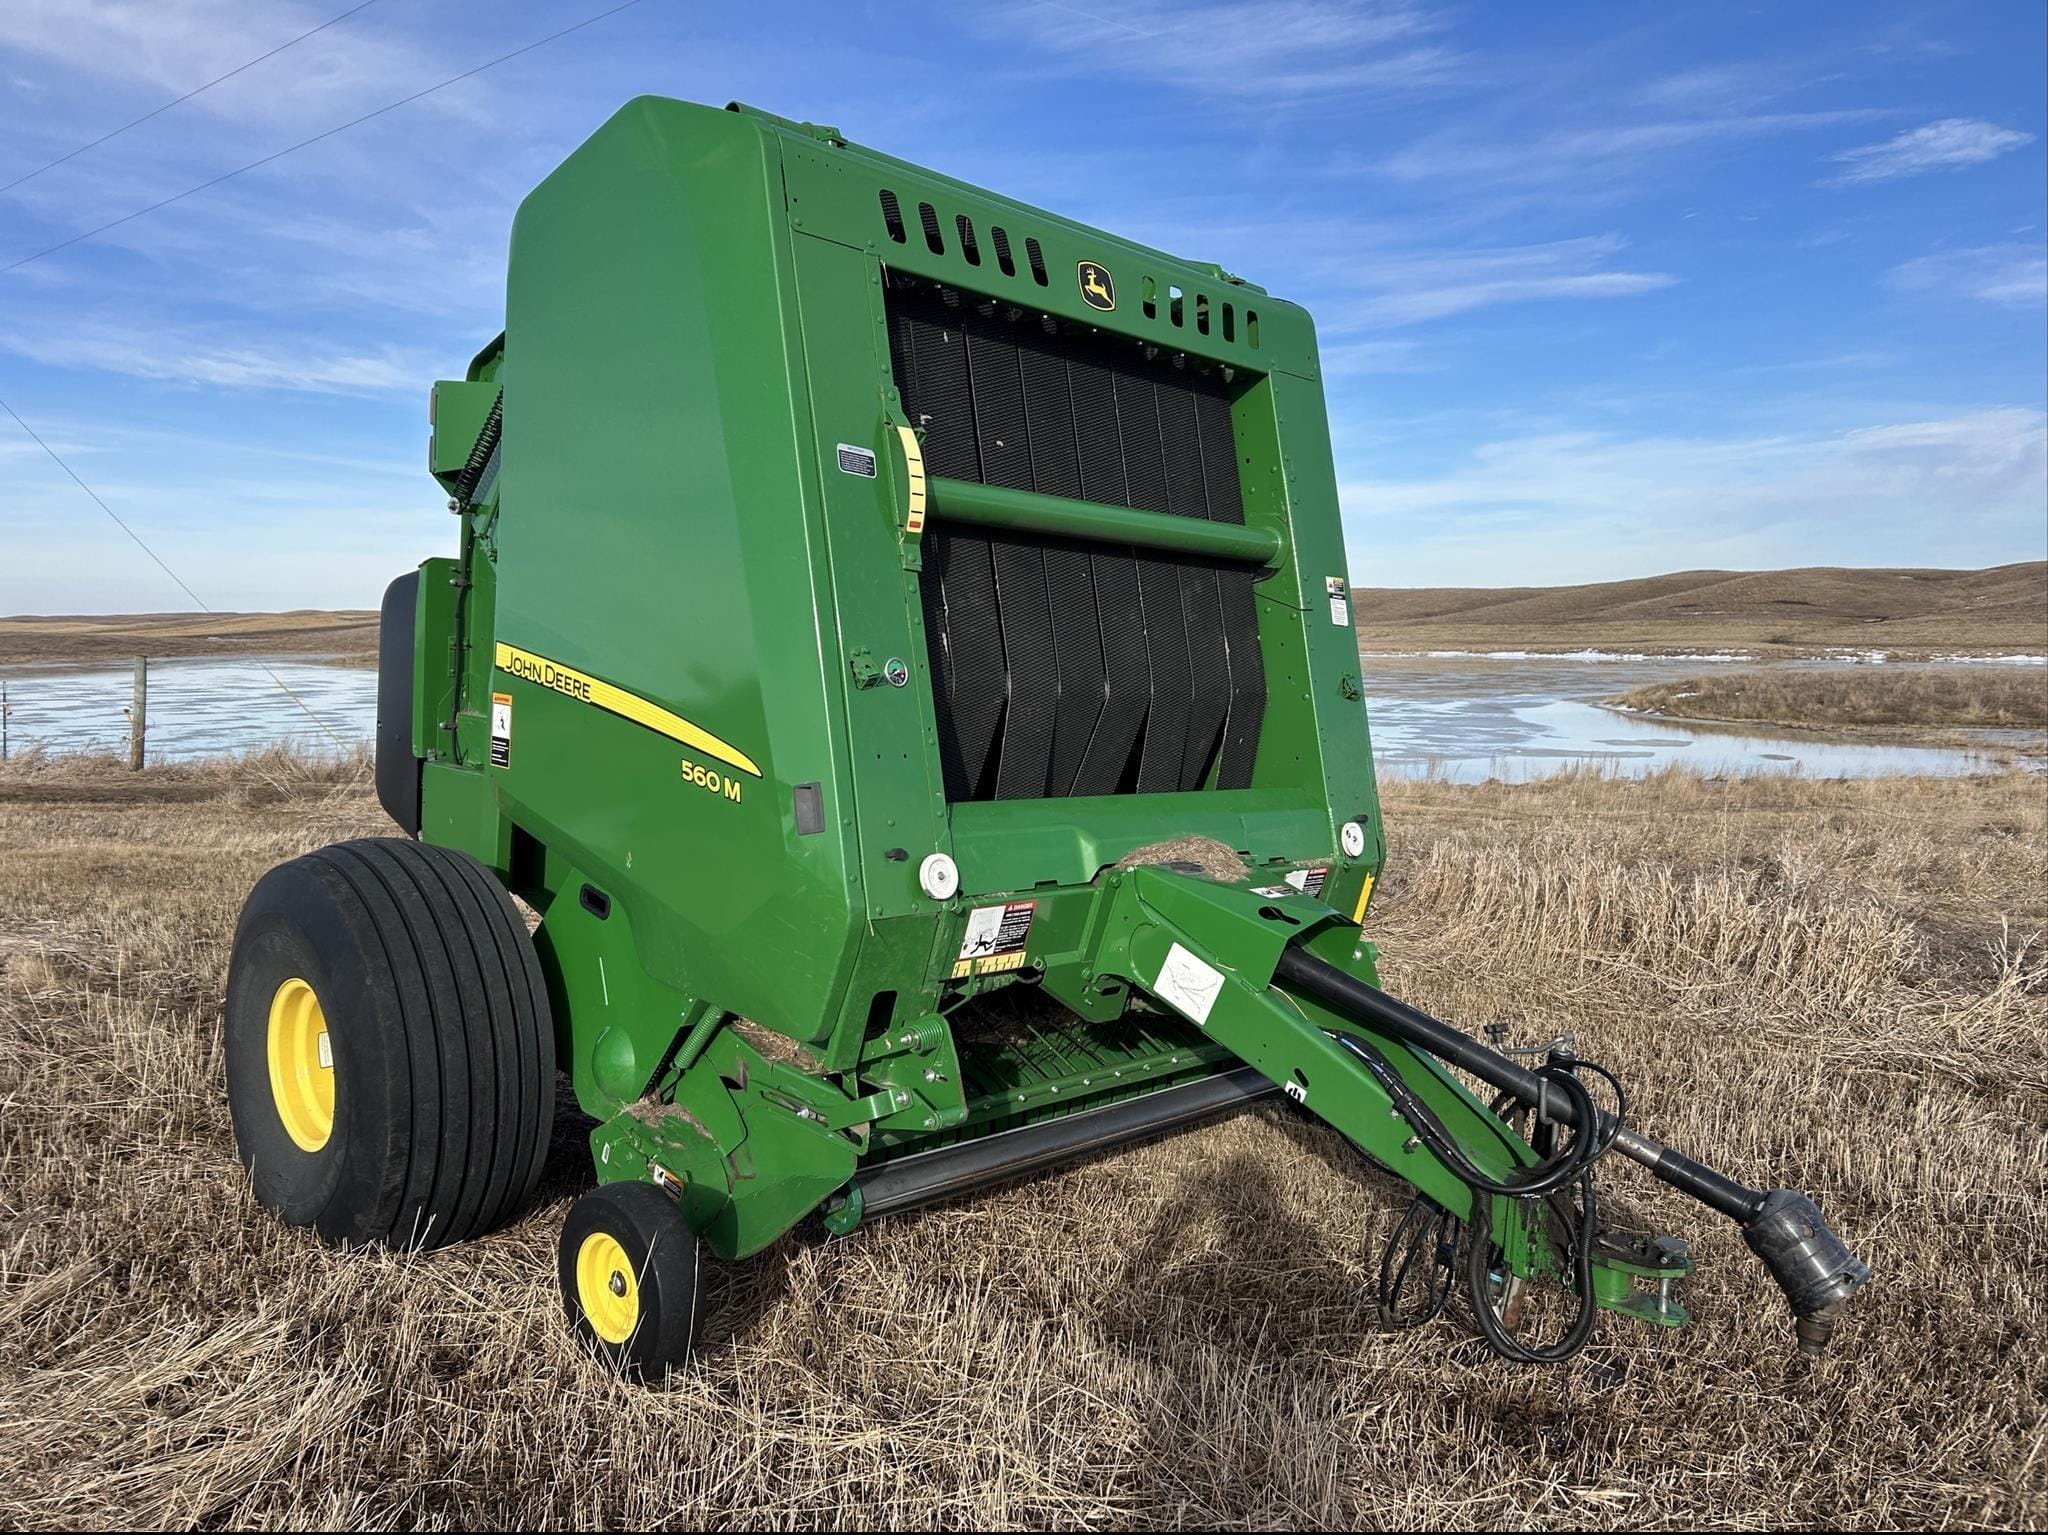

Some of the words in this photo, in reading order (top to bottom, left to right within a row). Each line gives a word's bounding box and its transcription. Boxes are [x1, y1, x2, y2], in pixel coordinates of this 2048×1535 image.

[505, 652, 542, 682] JOHN
[545, 664, 591, 700] DEERE
[681, 759, 721, 793] 560
[724, 776, 741, 804] M
